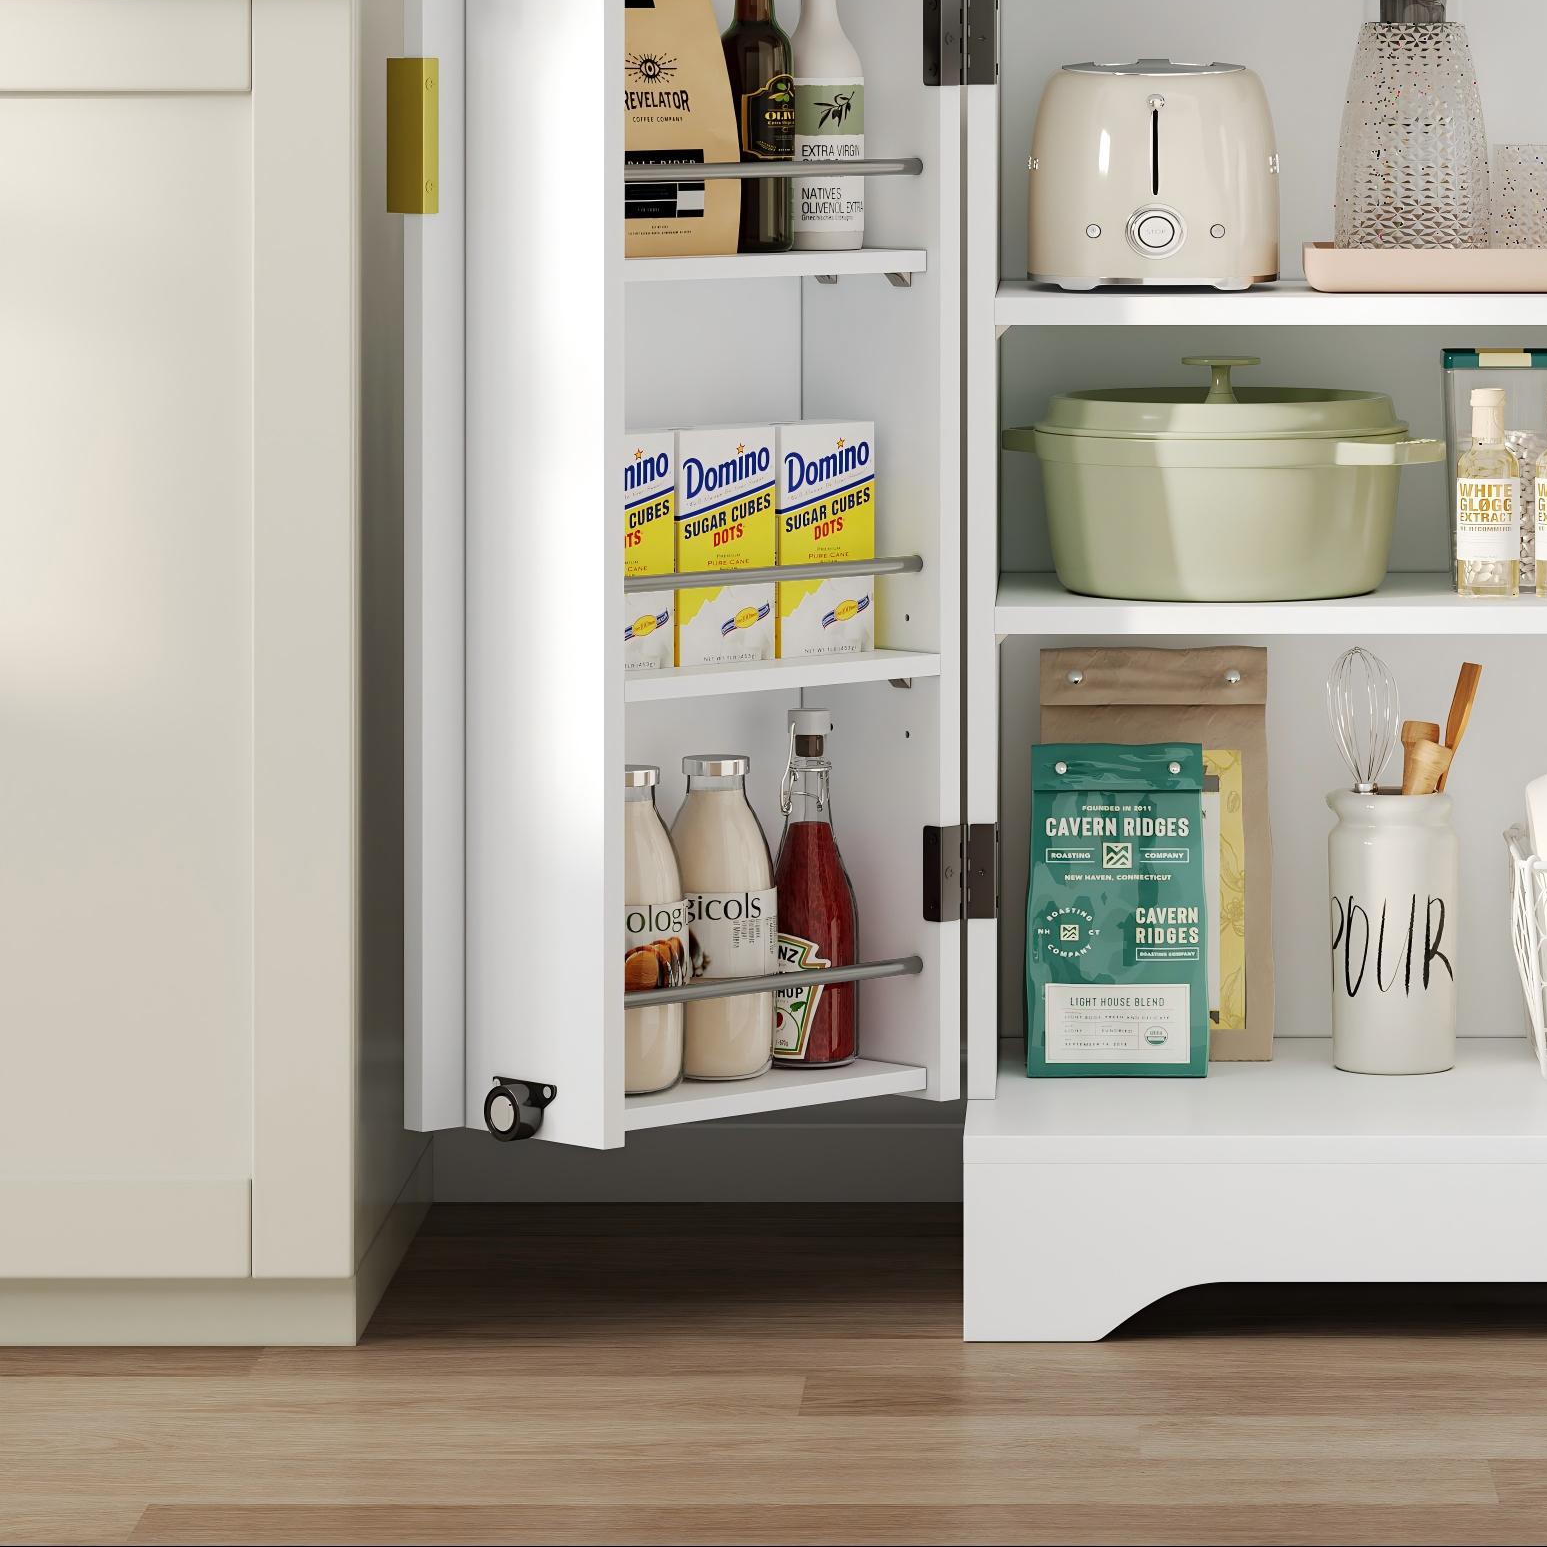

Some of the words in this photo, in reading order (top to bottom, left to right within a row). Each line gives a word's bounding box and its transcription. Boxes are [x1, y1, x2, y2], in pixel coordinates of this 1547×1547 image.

[801, 144, 834, 157] EXTRA
[836, 144, 860, 157] VIRGIN
[801, 187, 842, 200] NATIVES
[682, 446, 770, 500] Domino
[784, 441, 870, 494] Domino
[1460, 484, 1512, 497] WHITE
[785, 504, 827, 533] SUGAR
[831, 486, 871, 515] CUBES
[1460, 498, 1512, 511] GLØGG
[629, 499, 670, 529] CUBES
[684, 508, 728, 539] SUGAR
[732, 492, 771, 528] CUBES
[1460, 513, 1512, 522] EXTRACT
[713, 523, 744, 548] DOTS
[814, 516, 844, 542] DOTS
[1045, 817, 1117, 837] CAVERN
[1123, 817, 1190, 837] RIDGES
[1085, 874, 1114, 882] HAVEN,
[1046, 906, 1093, 922] ROASTING
[1135, 906, 1199, 925] CAVERN
[1135, 927, 1199, 944] RIDGES
[1047, 944, 1092, 958] COMPANY
[1331, 893, 1454, 999] POUR
[1070, 997, 1097, 1007] LIGHT
[1100, 997, 1131, 1007] HOUSE
[1134, 997, 1165, 1007] BLEND
